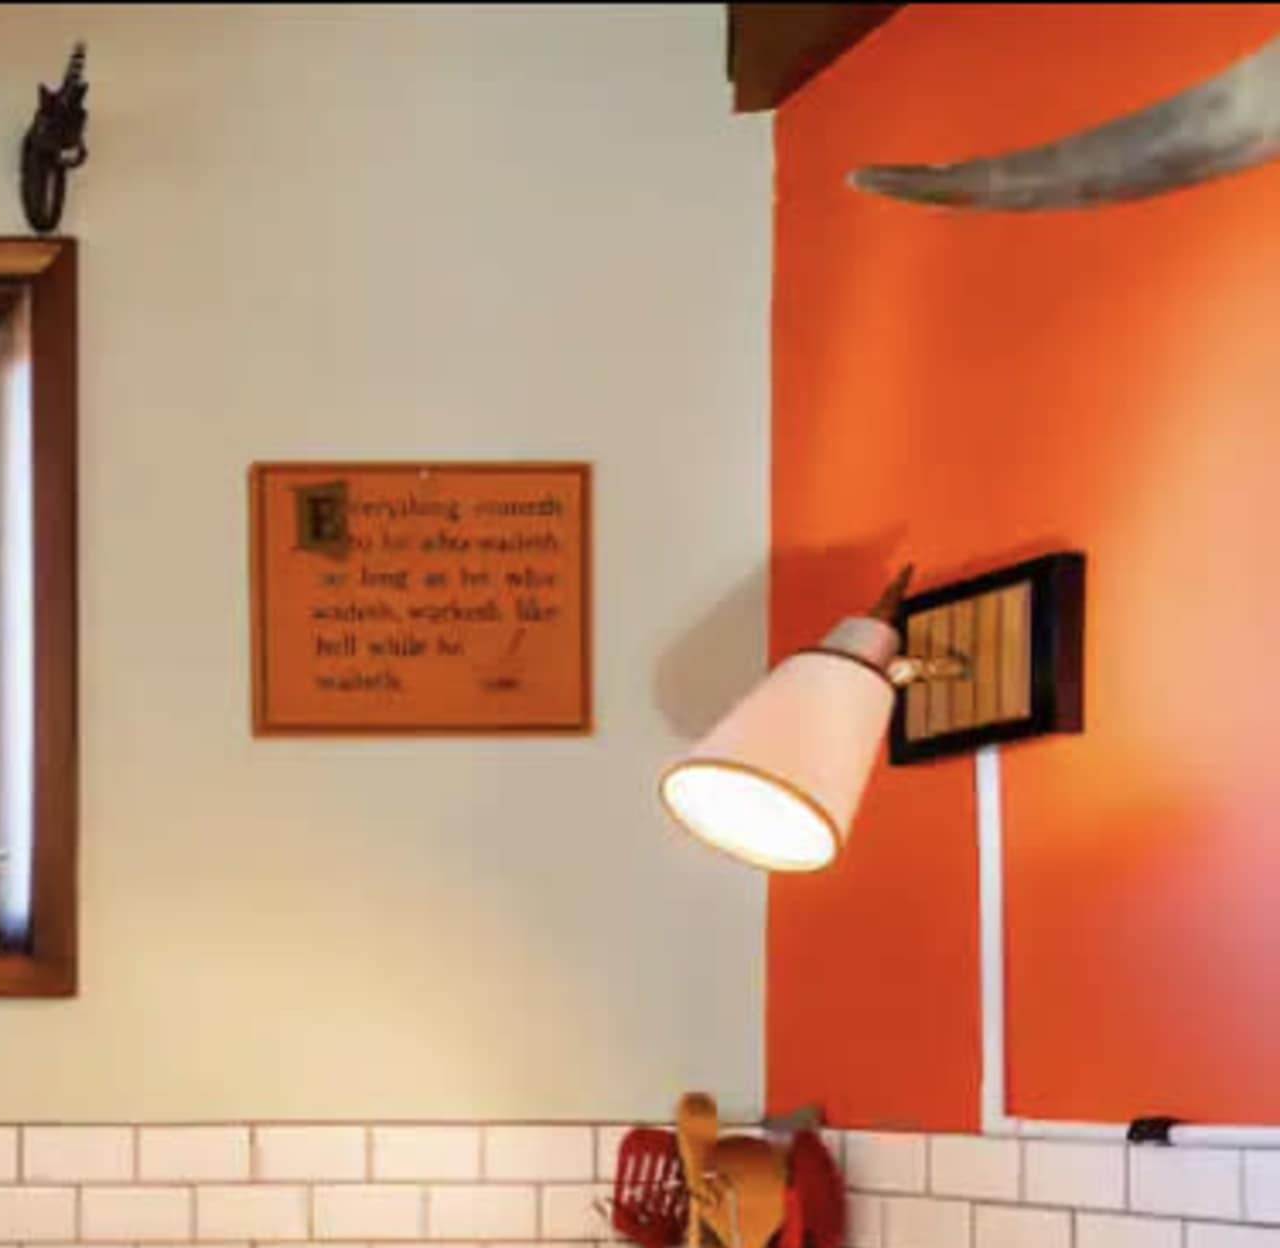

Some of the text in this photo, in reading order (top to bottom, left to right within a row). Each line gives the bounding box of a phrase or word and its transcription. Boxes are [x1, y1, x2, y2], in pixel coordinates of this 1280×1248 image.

[361, 566, 409, 590] long
[515, 597, 559, 621] like
[316, 634, 357, 656] hell
[367, 633, 429, 656] while
